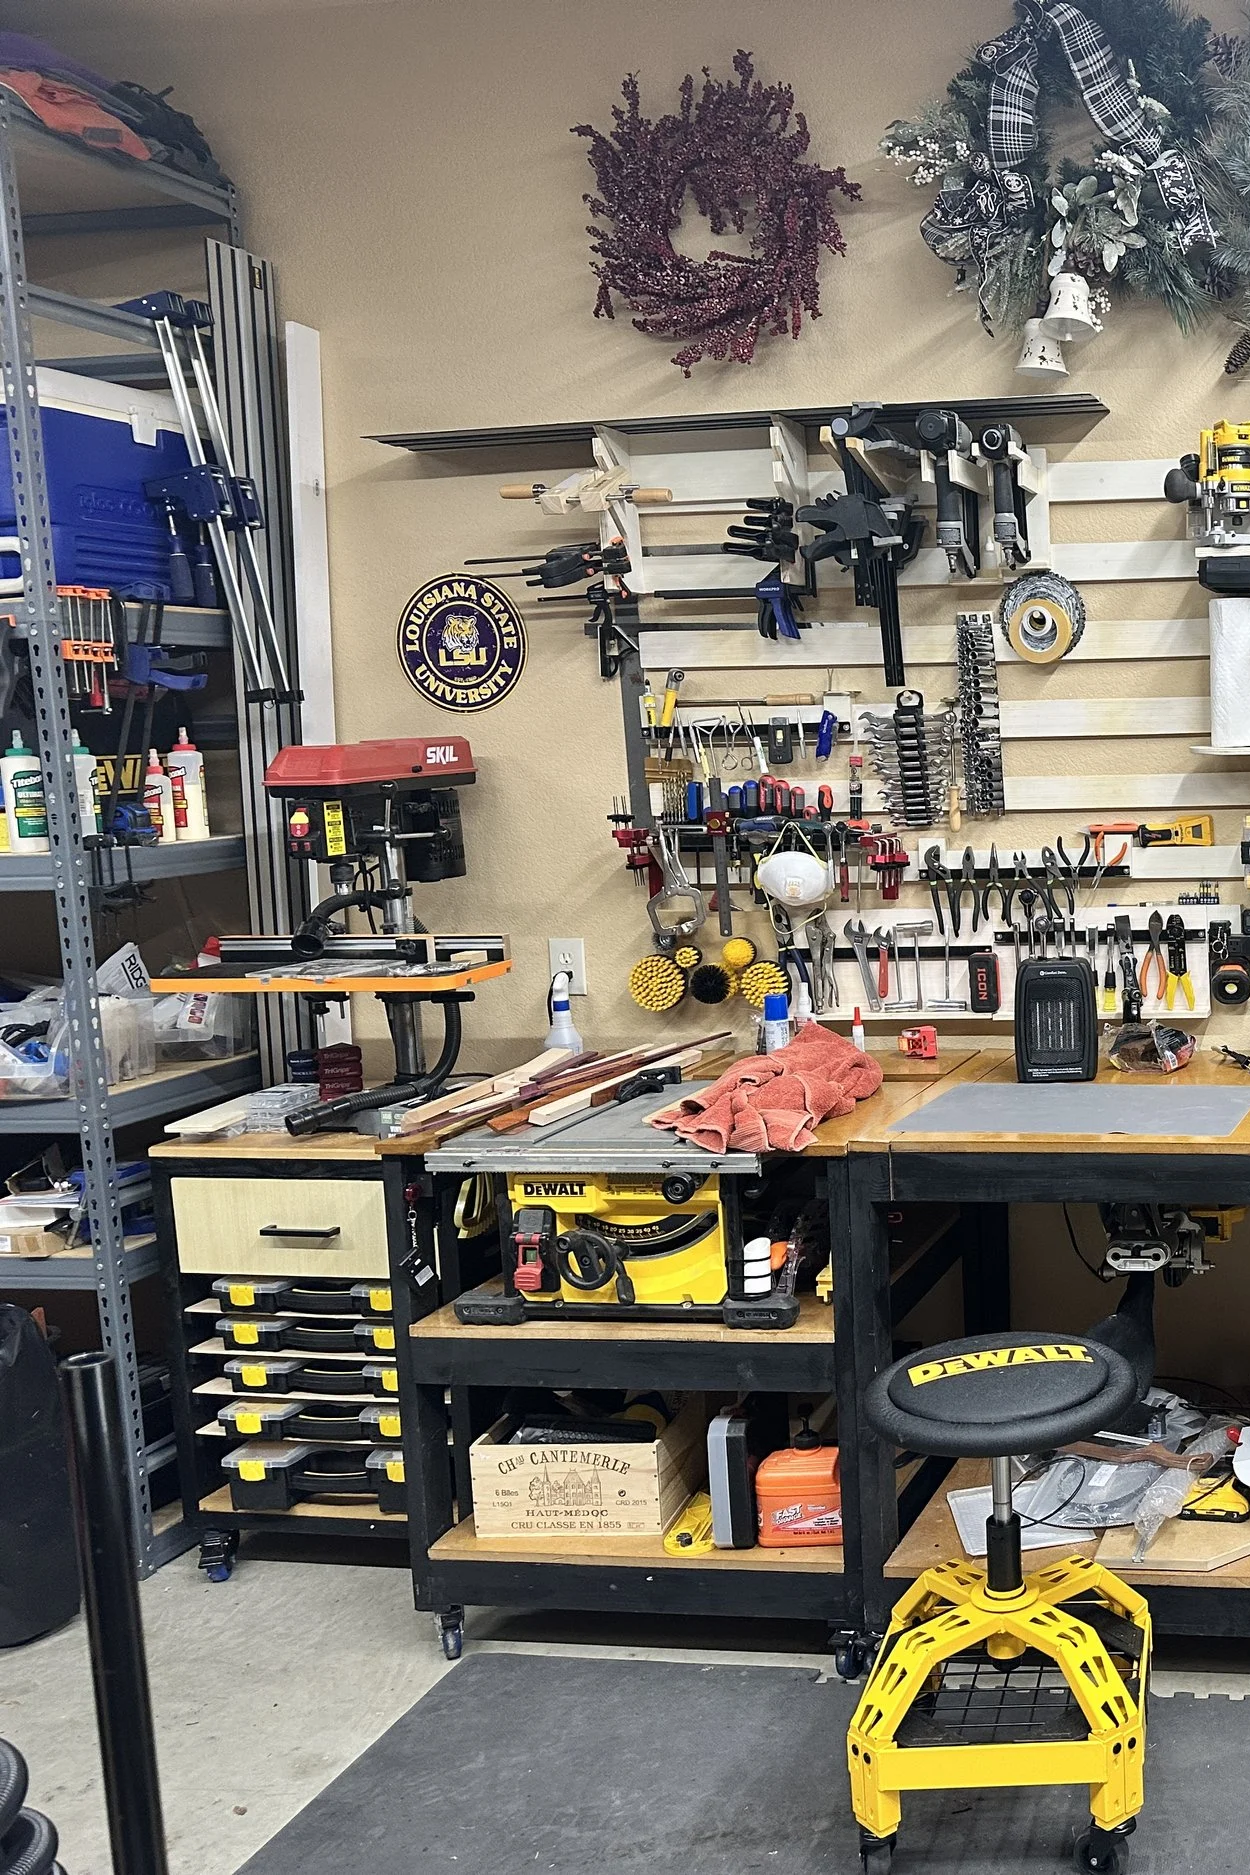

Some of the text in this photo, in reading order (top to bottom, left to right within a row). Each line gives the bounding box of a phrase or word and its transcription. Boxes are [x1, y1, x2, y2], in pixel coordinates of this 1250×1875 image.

[406, 582, 517, 653] LOUISIANA STATE
[438, 647, 487, 666] LSU
[415, 660, 513, 703] UNIVERSITY
[426, 745, 459, 765] SKIL
[11, 774, 43, 789] Titebo
[125, 953, 148, 989] RIDG
[976, 968, 988, 1000] ICON
[523, 1183, 586, 1196] DEWALT
[908, 1344, 1091, 1387] DEWALT
[530, 1450, 631, 1475] CANTEMERLE
[525, 1508, 609, 1518] HAUT-MÉDOC
[776, 1503, 803, 1518] FAST
[511, 1521, 534, 1530] CRU
[536, 1521, 577, 1530] CLASSE
[579, 1520, 595, 1529] EN
[598, 1520, 622, 1529] 1855
